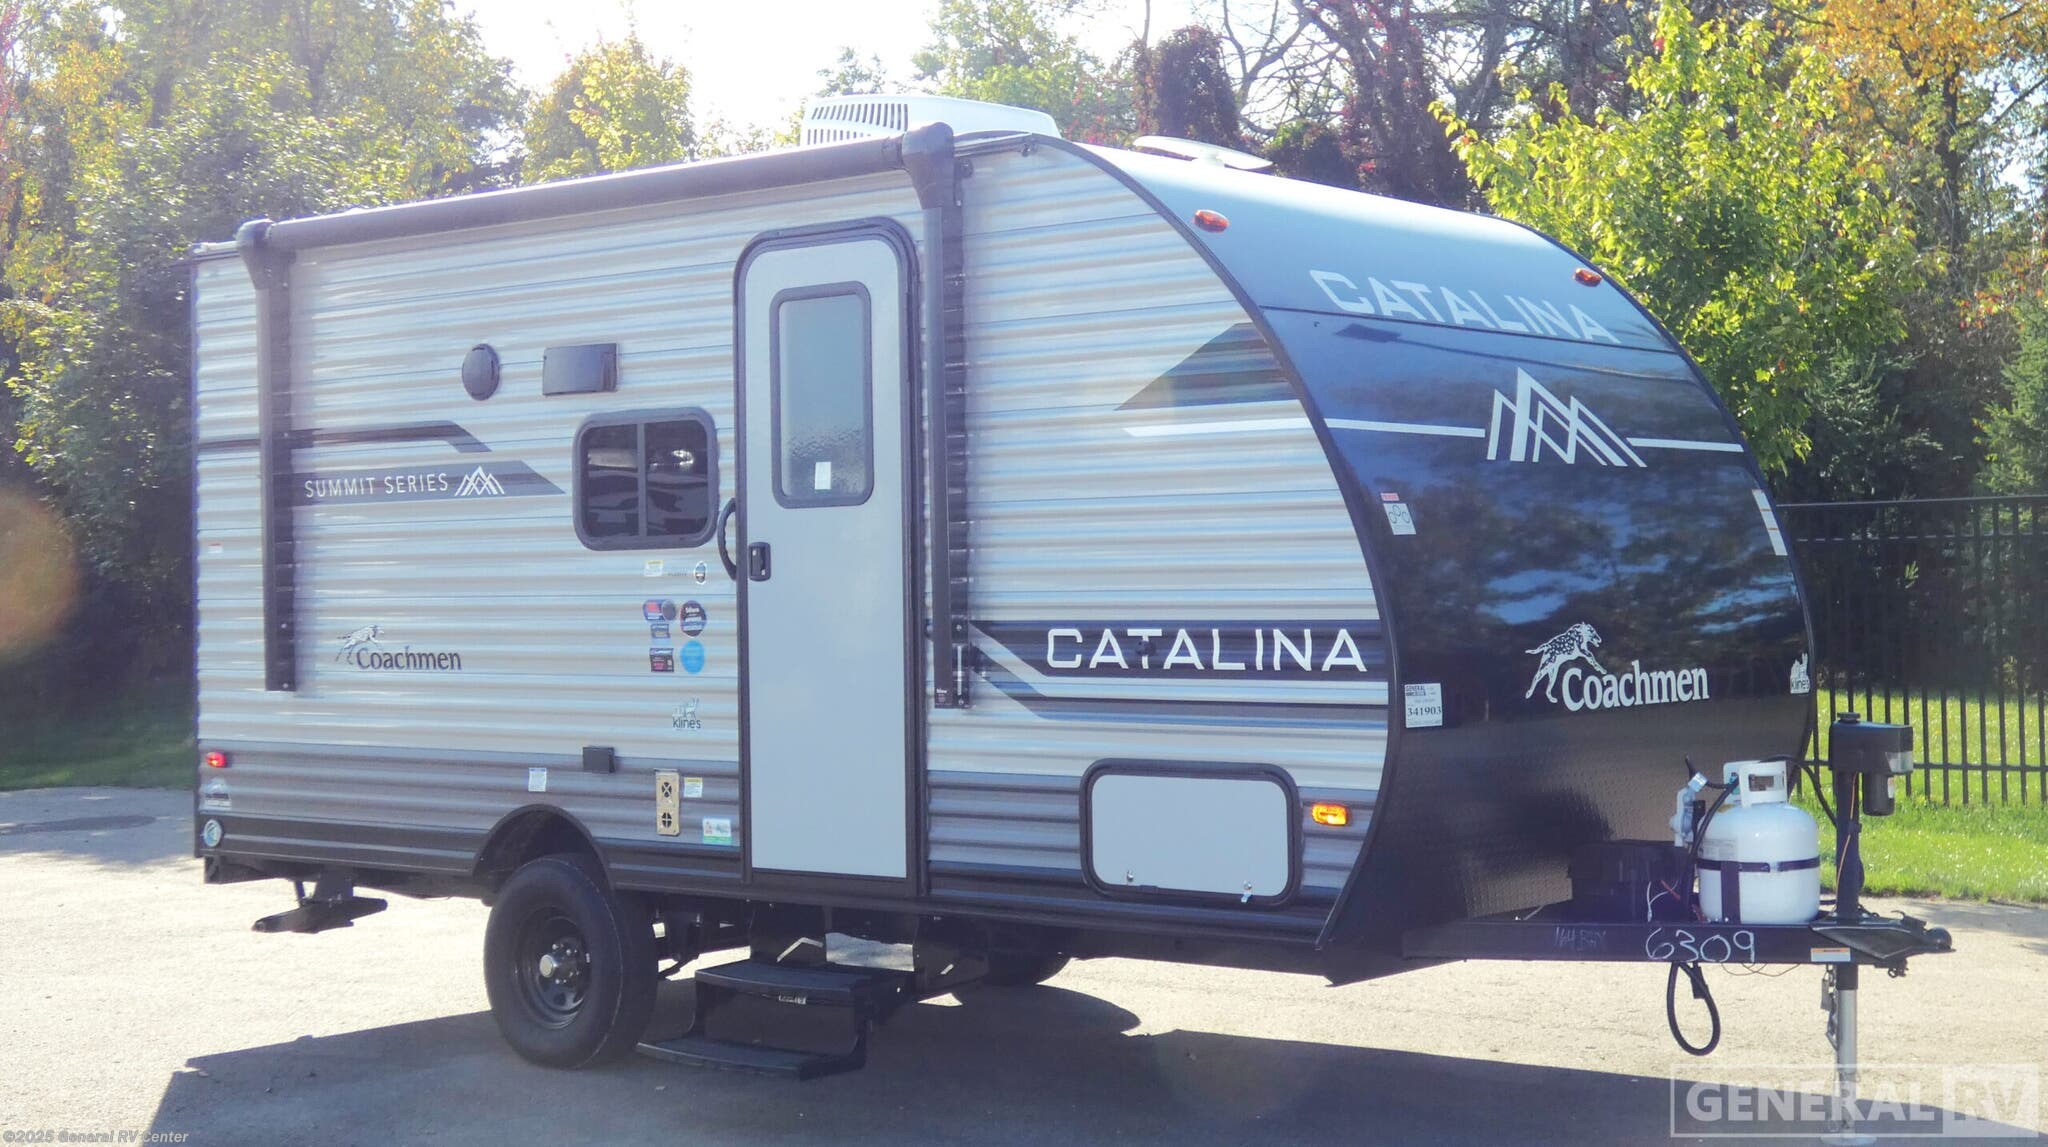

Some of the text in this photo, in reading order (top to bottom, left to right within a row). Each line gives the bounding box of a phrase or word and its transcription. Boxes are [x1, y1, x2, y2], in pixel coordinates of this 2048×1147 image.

[1309, 269, 1622, 344] CATALINA
[305, 473, 449, 498] SUMMIT SERIES
[356, 646, 462, 671] Coachmen
[1047, 628, 1367, 673] CATALINA
[1562, 659, 1710, 711] Coachmen
[1407, 705, 1442, 716] 341903
[1645, 927, 1755, 962] 6309
